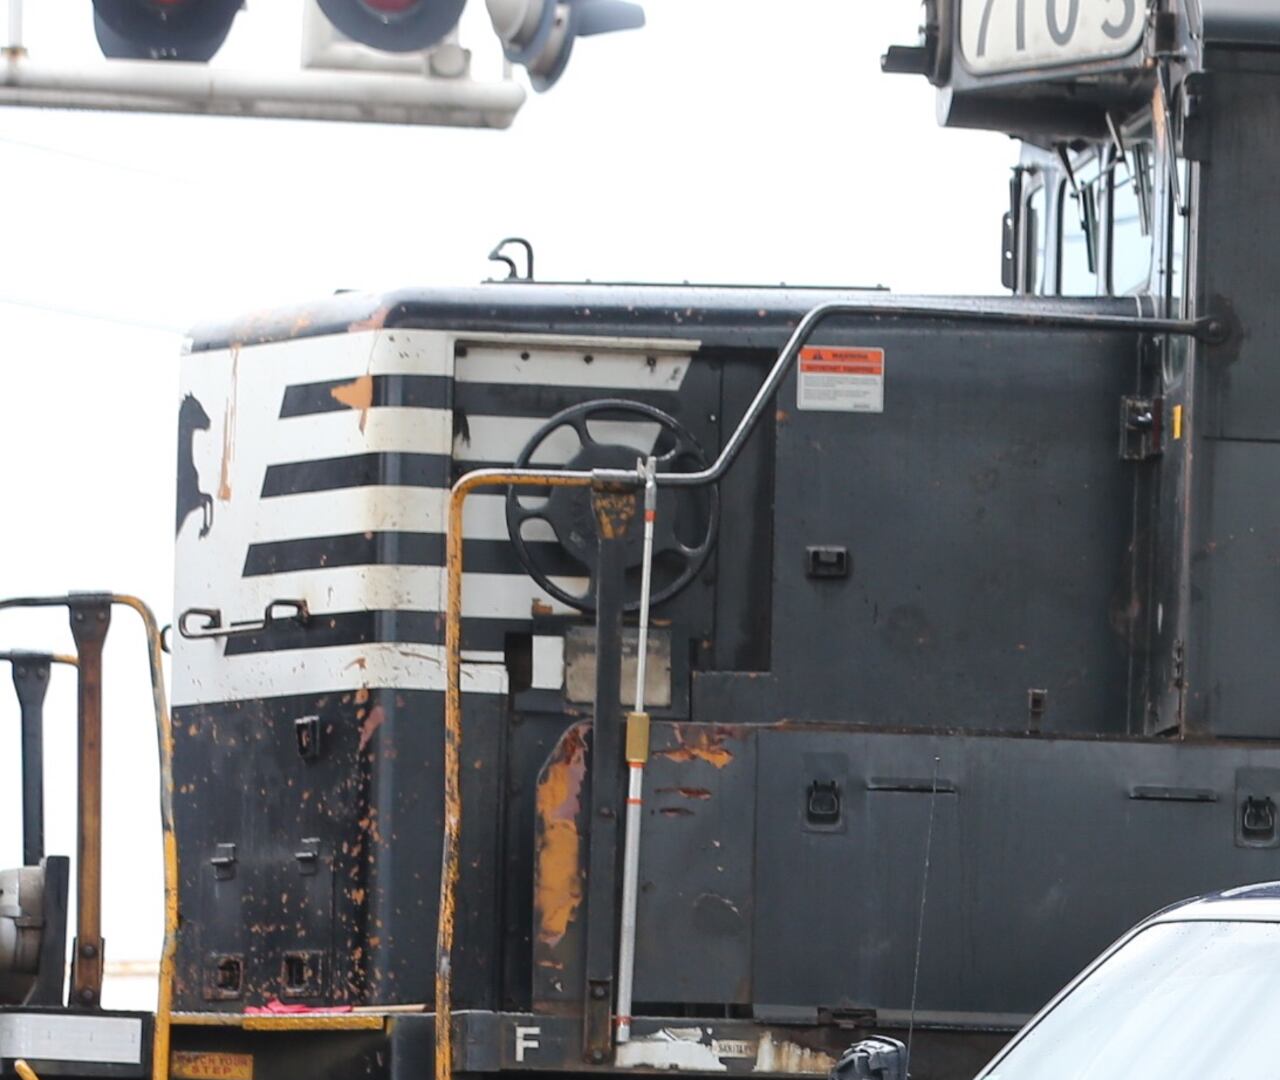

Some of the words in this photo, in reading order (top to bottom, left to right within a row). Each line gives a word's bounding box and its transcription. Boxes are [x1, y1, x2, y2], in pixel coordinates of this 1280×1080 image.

[516, 1026, 541, 1062] F
[217, 1055, 249, 1067] YOUR
[191, 1065, 232, 1076] STEP
